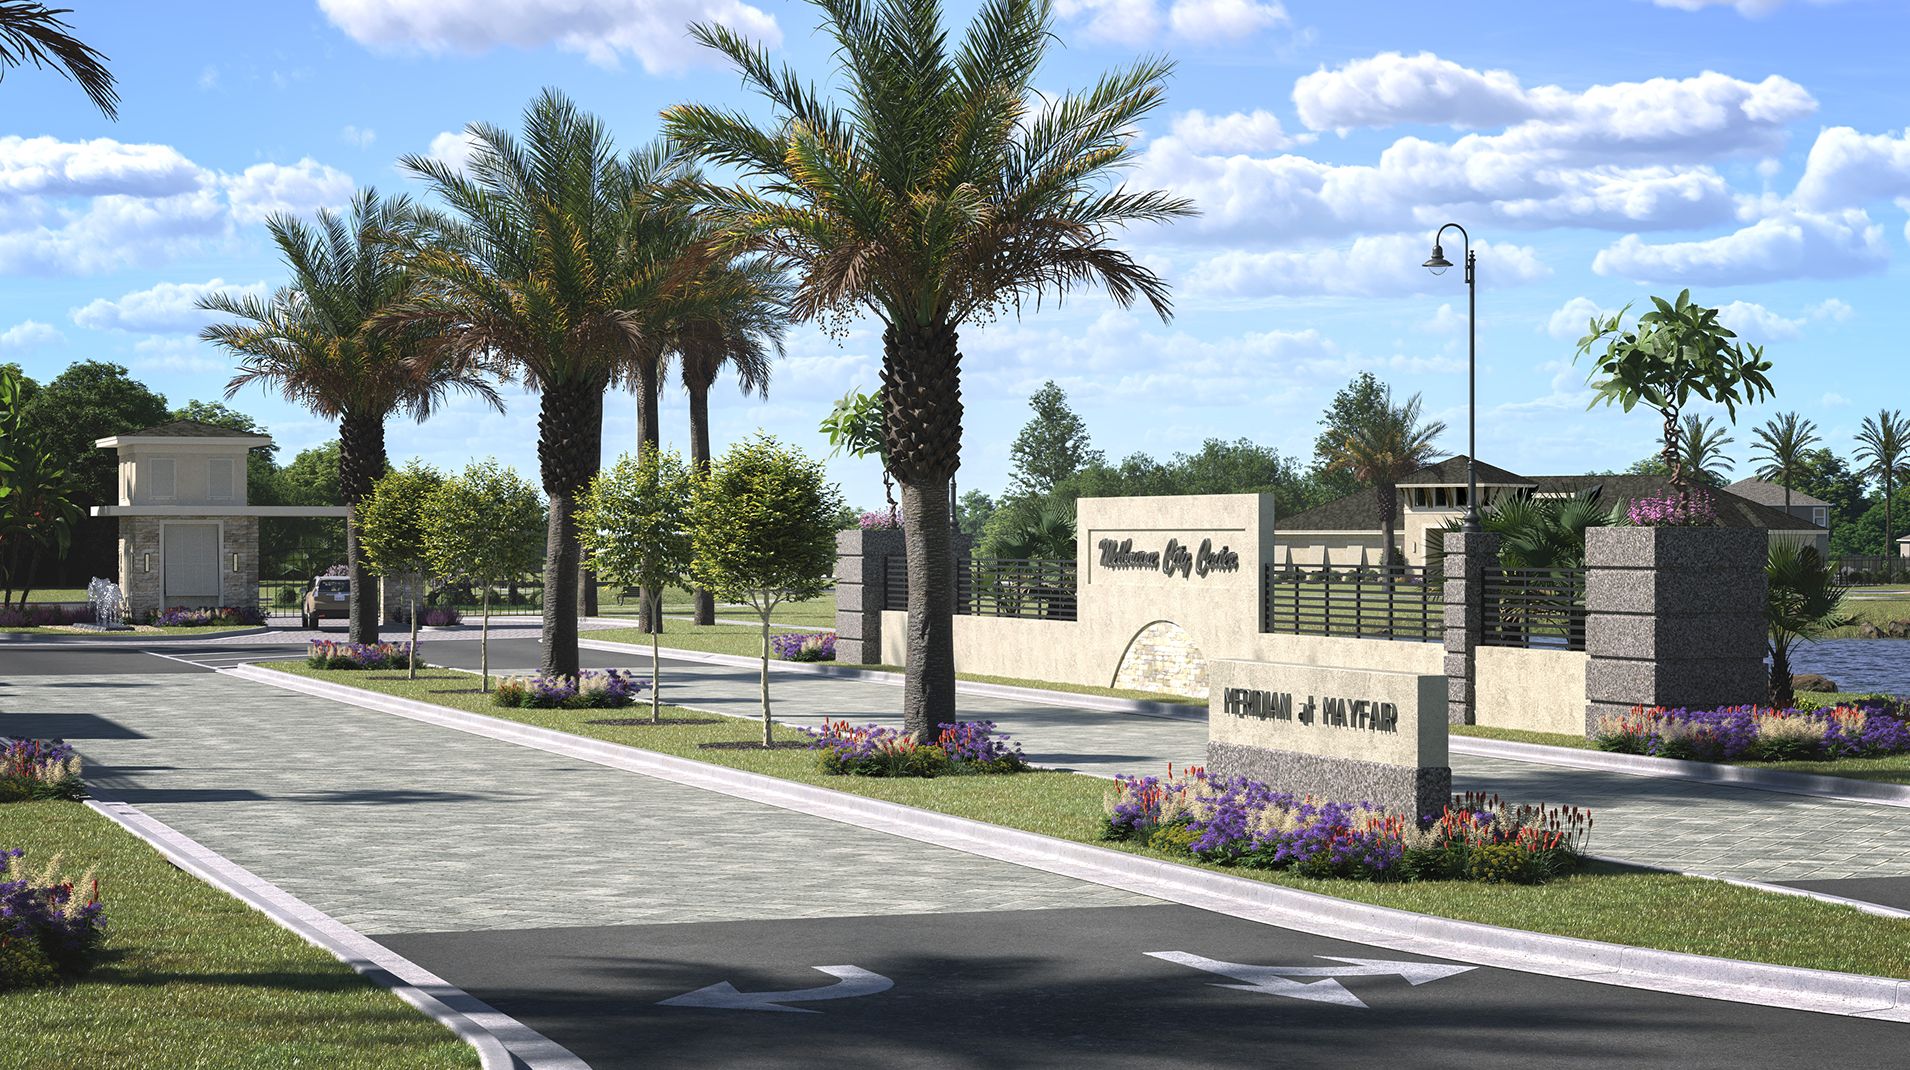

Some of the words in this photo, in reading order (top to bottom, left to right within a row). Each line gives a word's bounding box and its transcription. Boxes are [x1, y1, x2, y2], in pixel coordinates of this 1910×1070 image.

[1162, 538, 1193, 580] City
[1195, 538, 1239, 579] Center
[1224, 687, 1292, 722] MERIDIAN
[1298, 695, 1316, 726] at
[1322, 697, 1398, 735] MAYFAIR
